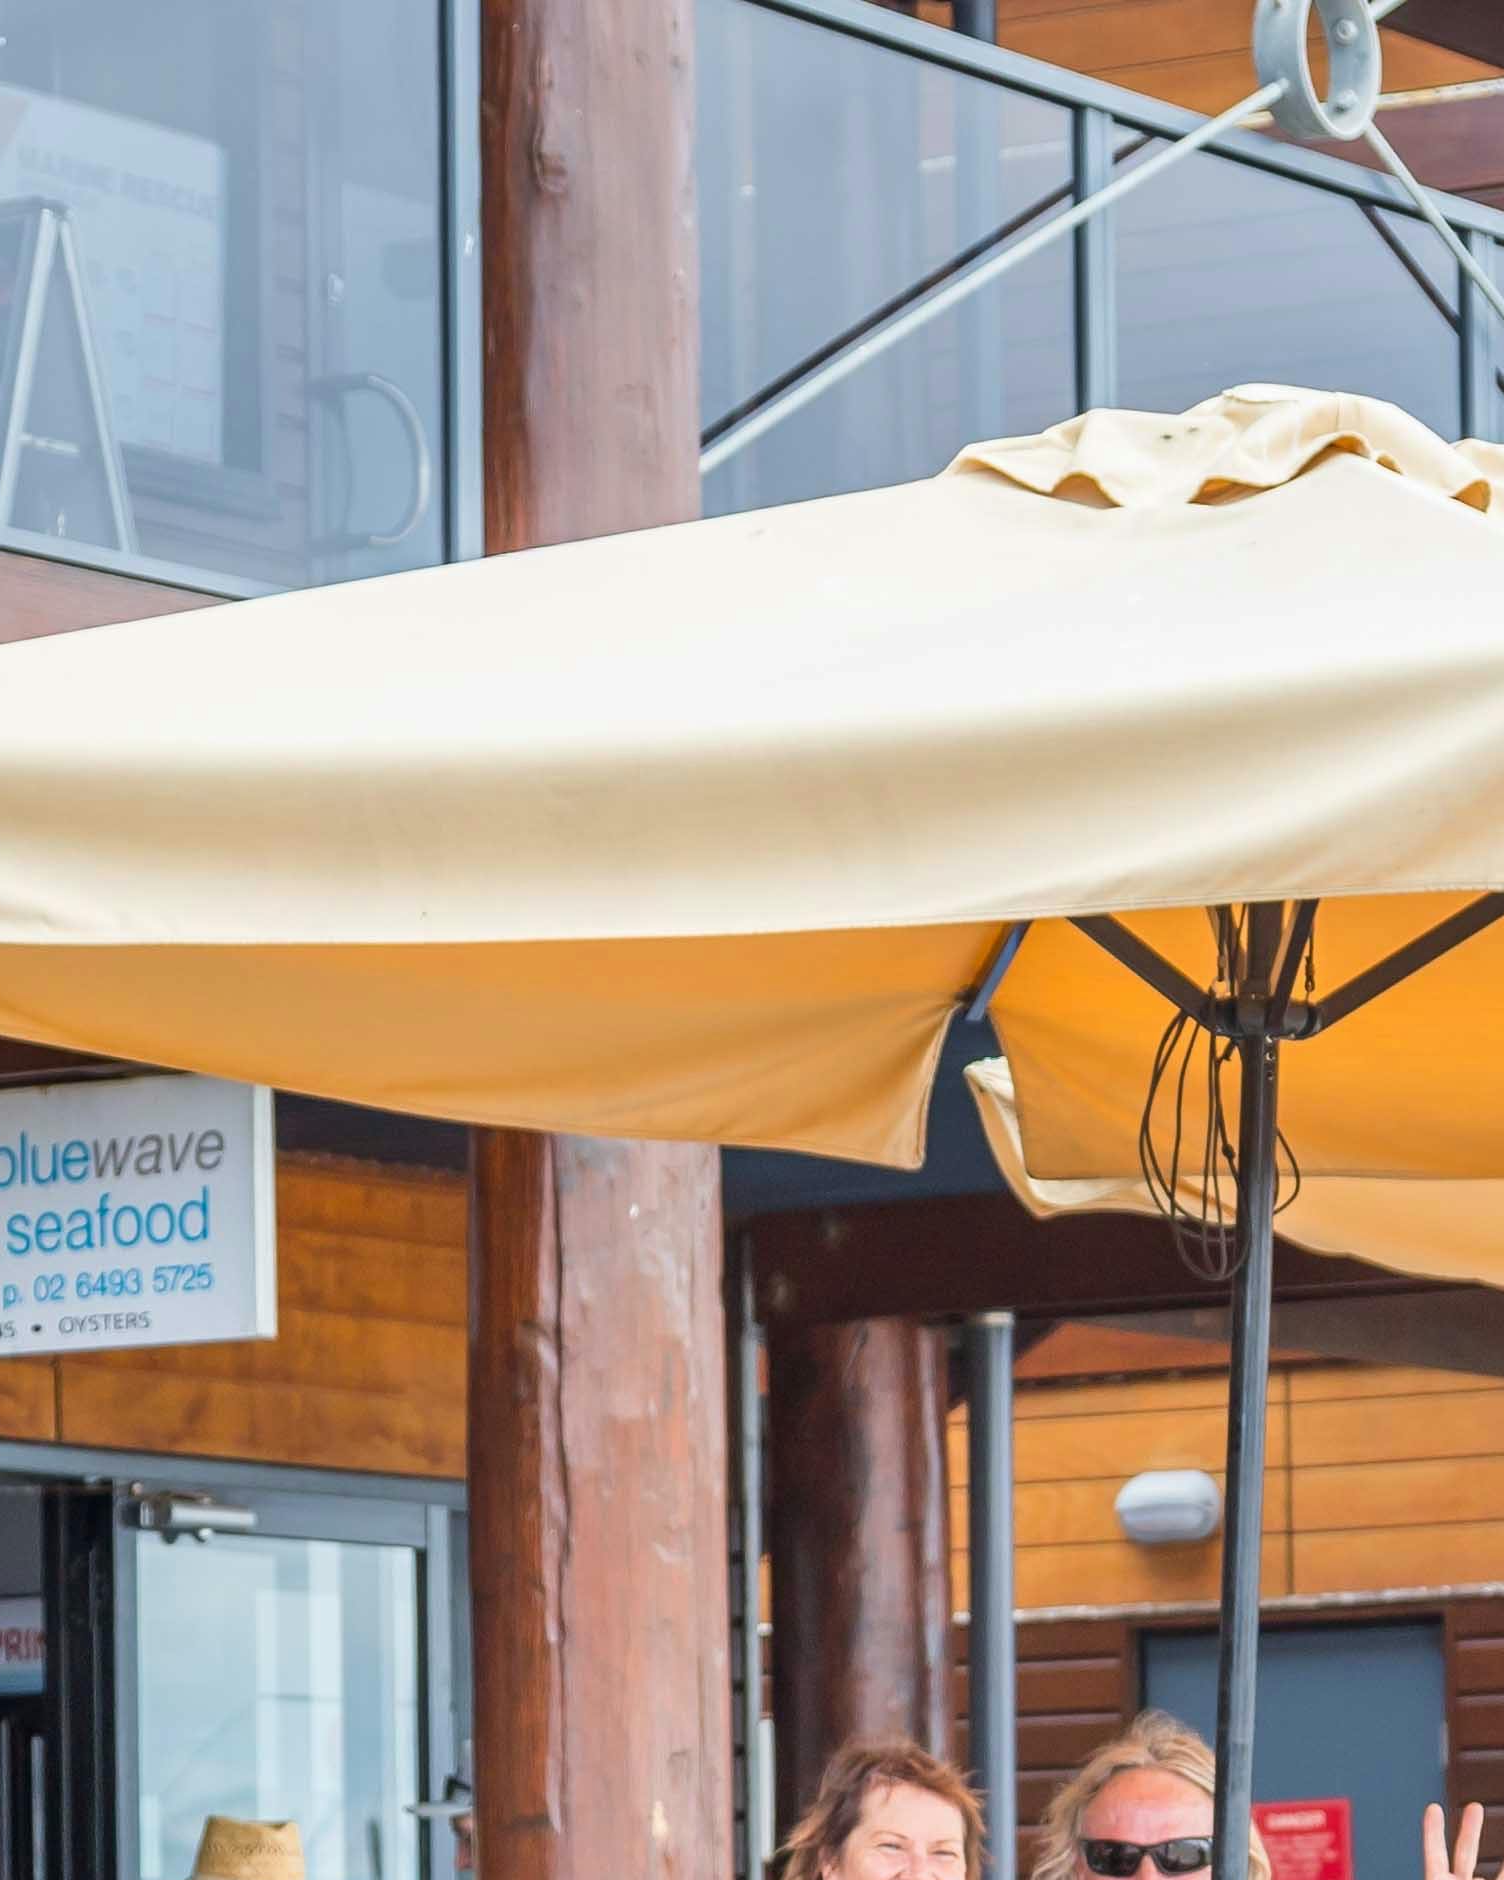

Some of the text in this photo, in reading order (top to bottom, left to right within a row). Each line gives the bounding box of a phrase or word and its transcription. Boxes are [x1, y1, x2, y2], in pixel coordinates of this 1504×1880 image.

[5, 1185, 211, 1256] seafood
[32, 1272, 66, 1302] 02
[75, 1267, 143, 1299] 6493
[152, 1262, 215, 1294] 5725
[56, 1310, 153, 1336] OYSTERS
